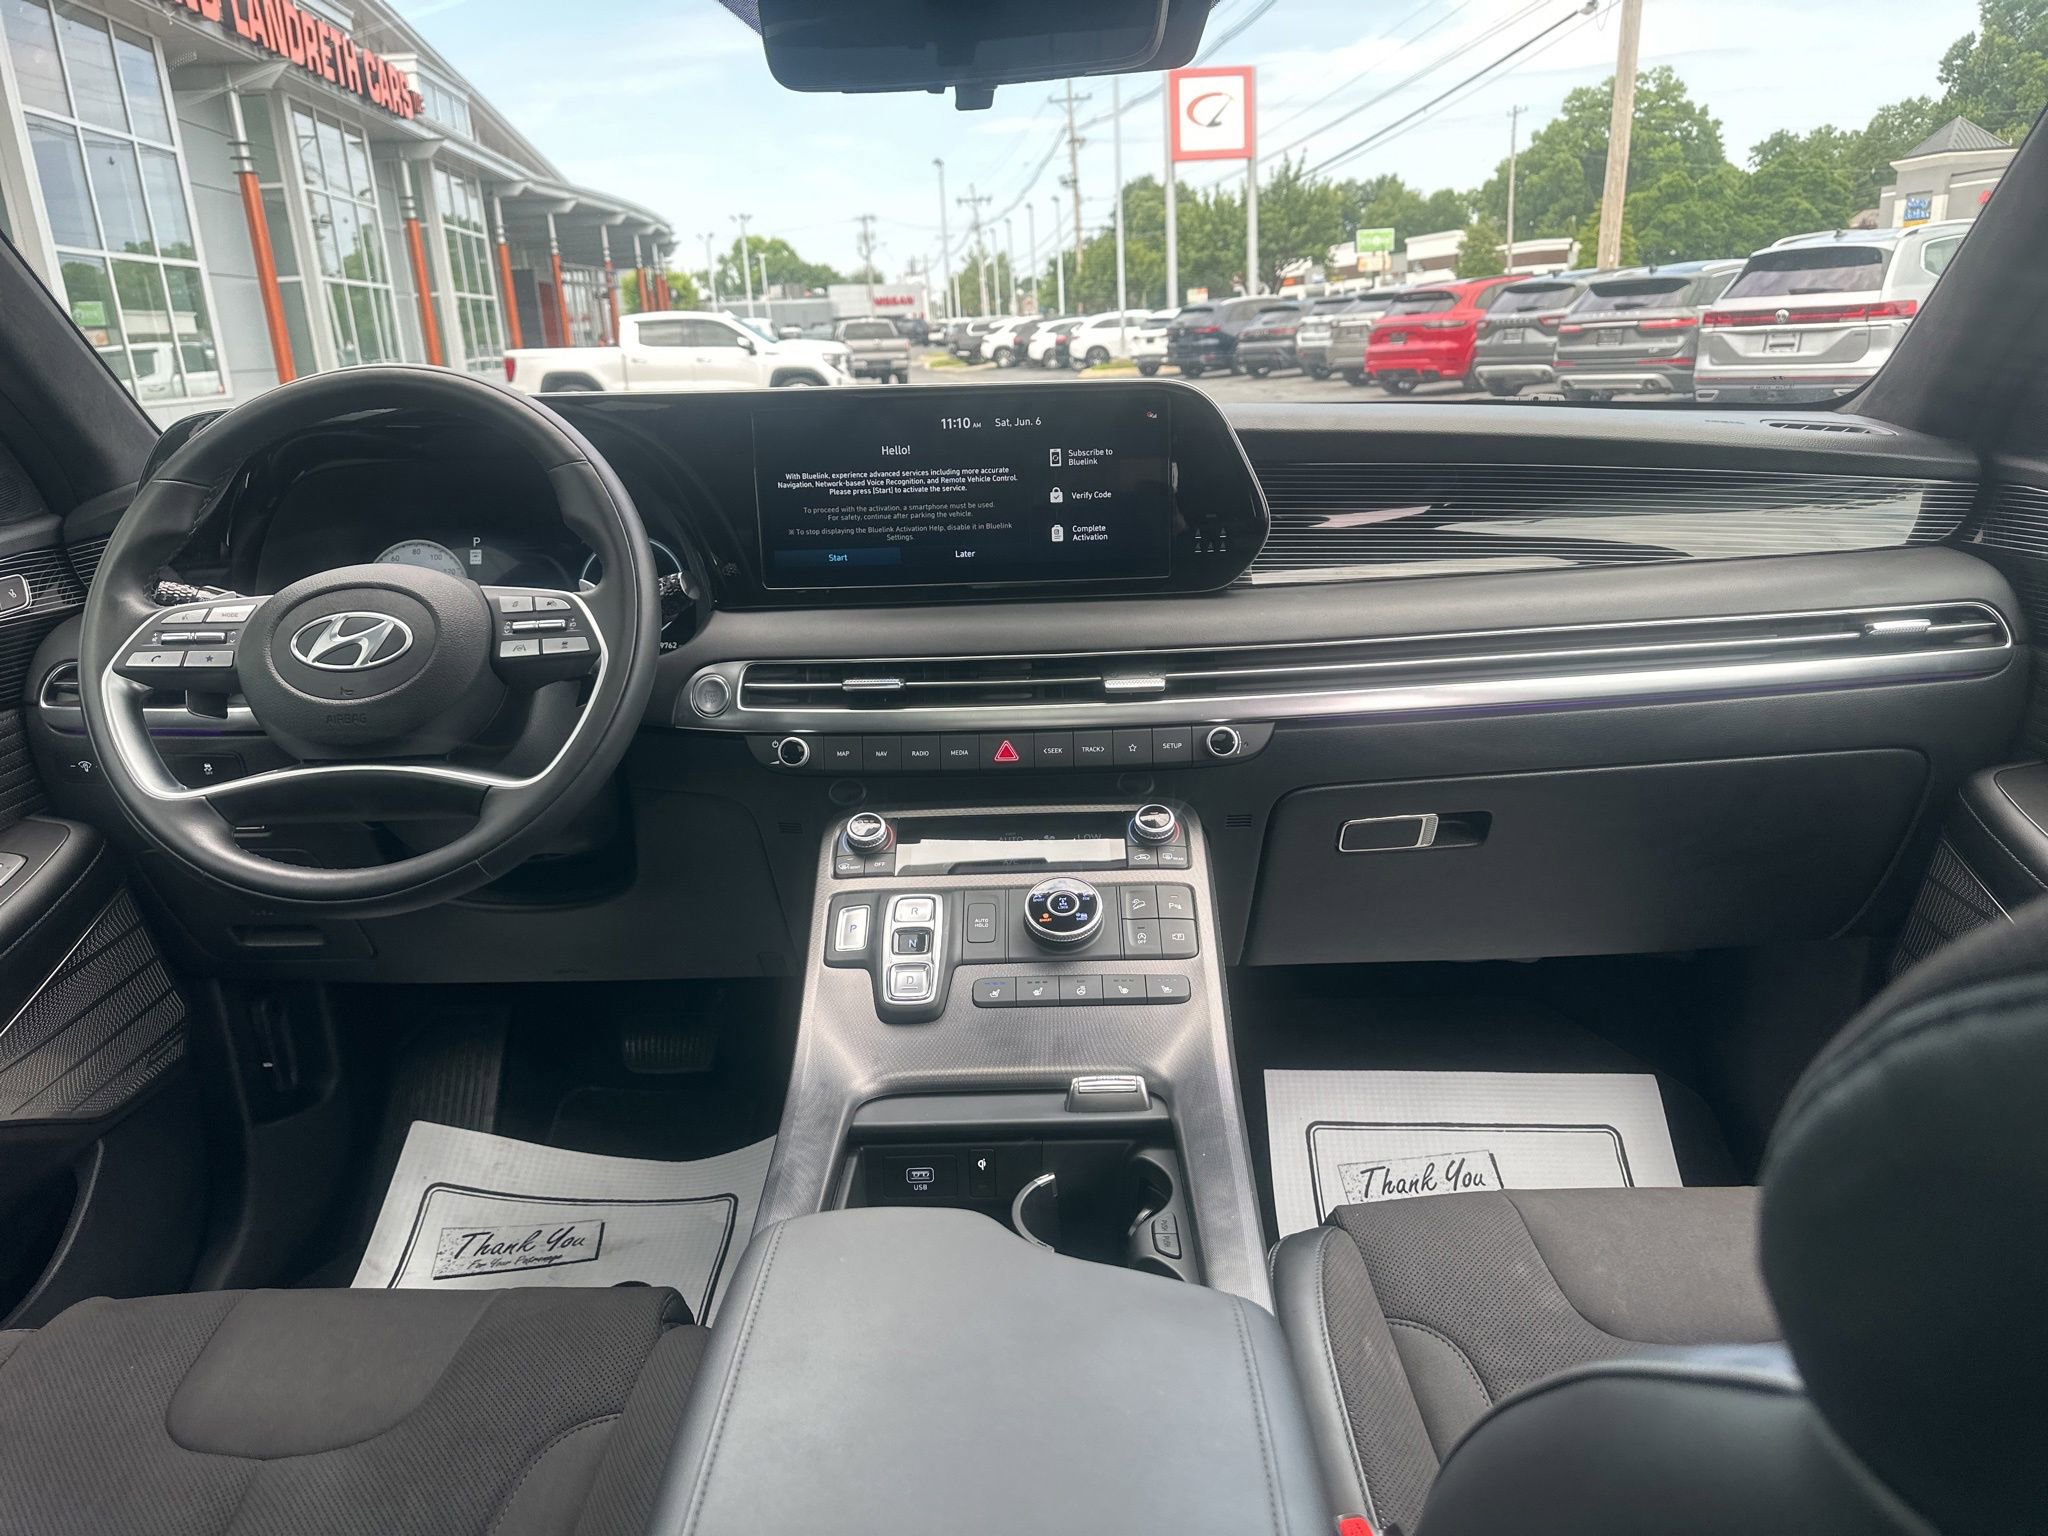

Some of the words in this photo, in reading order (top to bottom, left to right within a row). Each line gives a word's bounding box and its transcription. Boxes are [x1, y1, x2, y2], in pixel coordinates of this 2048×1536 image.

[231, 0, 363, 95] LANDRETH
[363, 47, 414, 119] CARS
[941, 418, 970, 429] 11:10
[1015, 417, 1033, 426] Jun.
[1036, 417, 1041, 426] 6
[881, 445, 910, 455] Hello!
[1068, 449, 1103, 457] Subscribe
[1068, 458, 1098, 466] Bluelink
[802, 472, 830, 480] Bluelink,
[832, 472, 868, 480] experience
[869, 470, 900, 478] advanced
[931, 468, 960, 477] including
[777, 482, 815, 490] Navigation,
[815, 479, 865, 488] Network-based
[886, 478, 926, 487] Recognition,
[853, 488, 871, 496] press
[903, 485, 929, 493] activate
[813, 506, 840, 515] proceed
[909, 504, 948, 512] smartphone
[841, 514, 862, 522] safety,
[911, 512, 936, 520] parking
[806, 528, 820, 536] stop
[821, 527, 855, 536] displaying
[1072, 525, 1106, 533] Complete
[473, 537, 480, 547] P
[1072, 533, 1108, 541] Activation
[828, 553, 848, 561] Start
[955, 550, 975, 558] Later
[911, 907, 918, 916] R
[850, 924, 857, 933] P
[908, 938, 918, 948] N
[906, 976, 914, 985] D
[1360, 1162, 1437, 1198] Thank
[1445, 1157, 1486, 1191] You
[454, 1230, 542, 1260] Thank
[547, 1226, 586, 1252] You
[467, 1260, 486, 1270] For
[490, 1257, 511, 1268] Your
